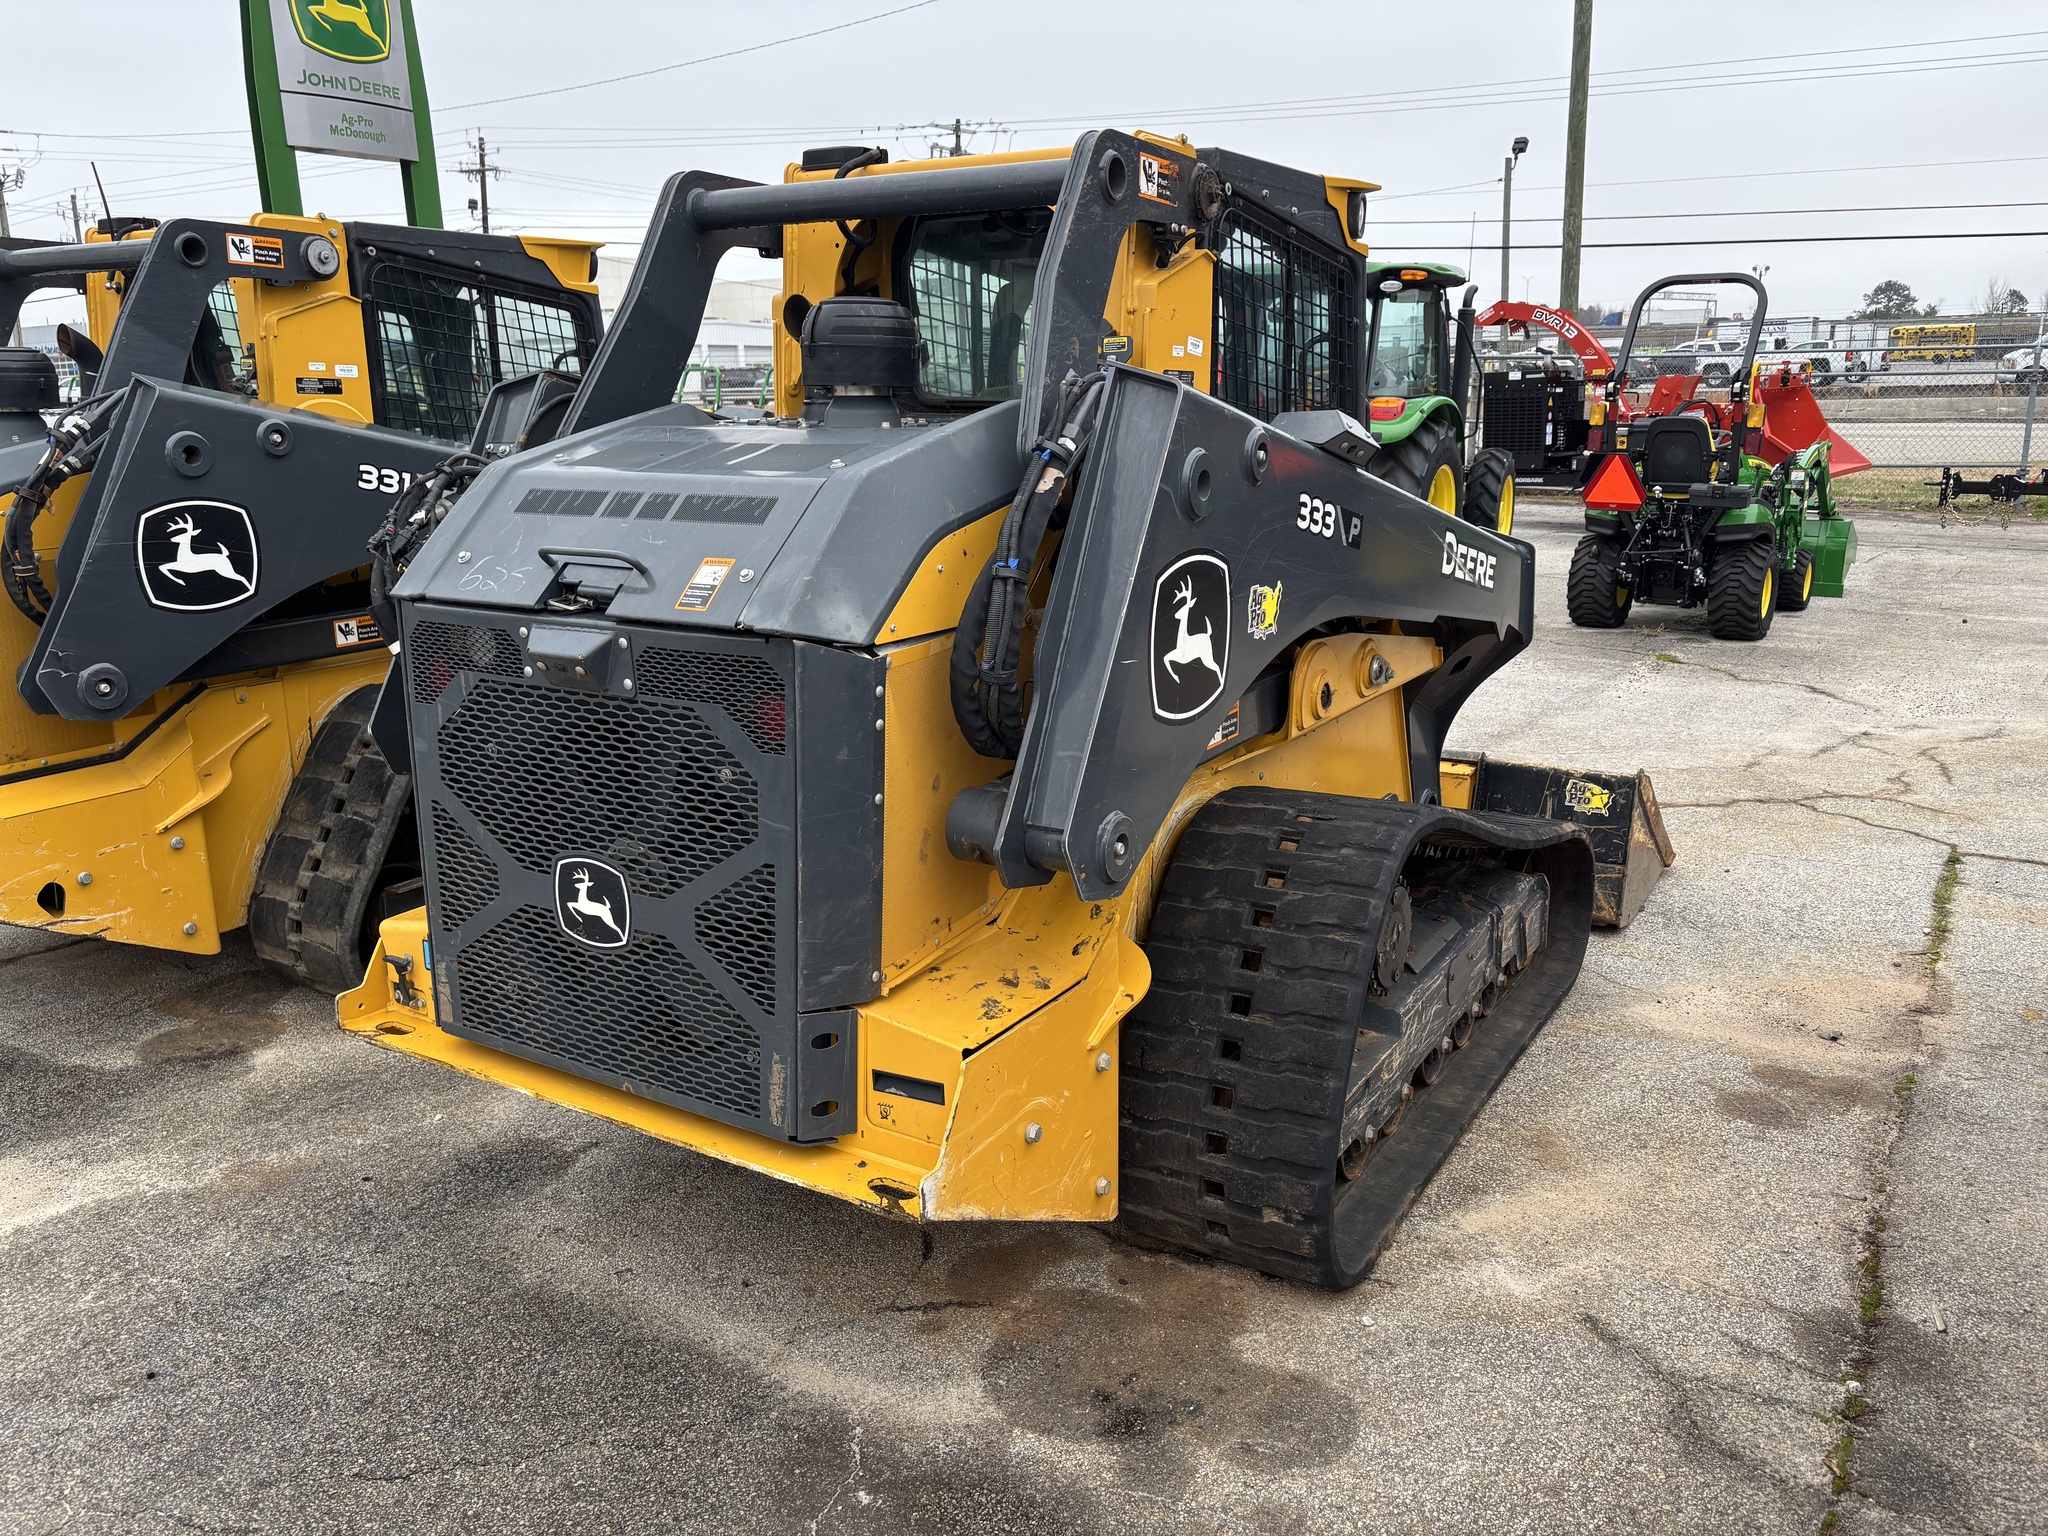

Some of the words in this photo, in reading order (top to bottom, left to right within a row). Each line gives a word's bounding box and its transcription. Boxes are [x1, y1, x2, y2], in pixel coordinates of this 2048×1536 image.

[297, 69, 347, 91] JOHN
[349, 75, 401, 100] DEERE
[341, 113, 374, 128] Ag-Pro
[329, 125, 387, 143] McDonough
[1532, 308, 1563, 330] BVR
[1561, 322, 1578, 339] 13
[1297, 493, 1336, 538] 333
[1441, 530, 1497, 589] DEERE
[1249, 609, 1266, 629] Pro
[1569, 781, 1592, 796] Ag-
[1567, 793, 1591, 805] Pro
